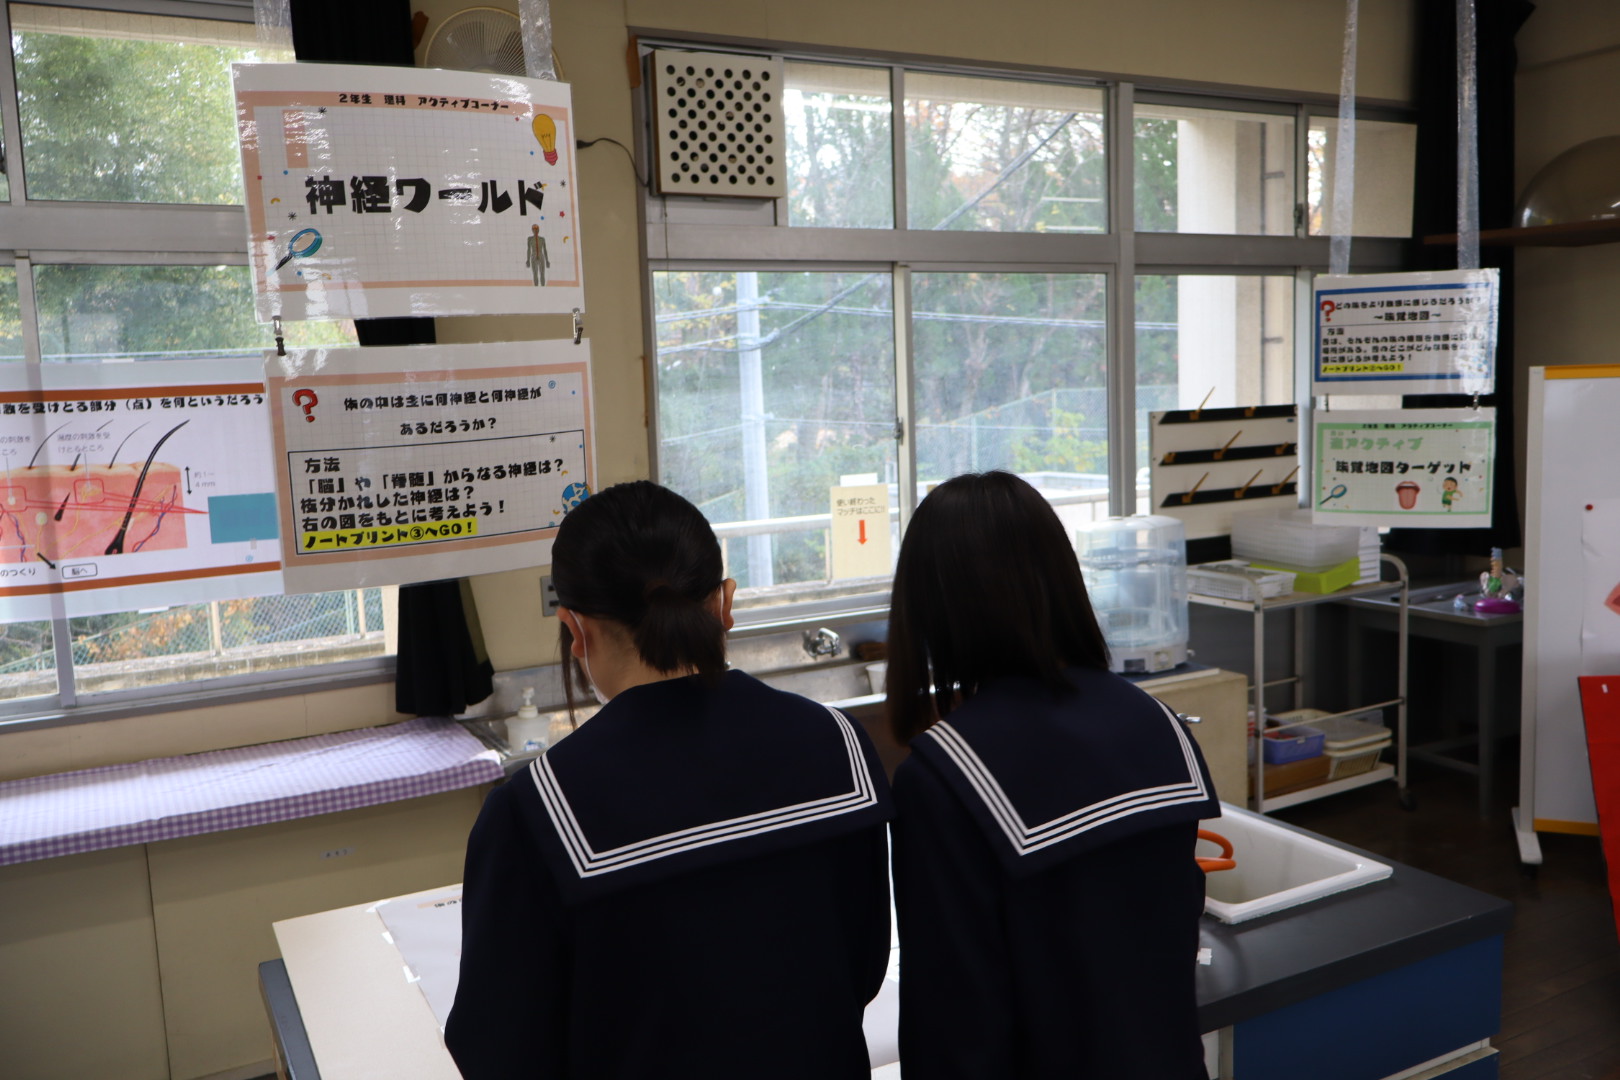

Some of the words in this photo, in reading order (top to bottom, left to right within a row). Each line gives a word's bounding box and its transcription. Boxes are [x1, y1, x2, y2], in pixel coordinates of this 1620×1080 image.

[338, 93, 373, 105] 2年生
[384, 94, 406, 106] 理科
[418, 95, 509, 111] アクティブコーナー
[305, 175, 545, 216] 神経ワールド
[0, 394, 264, 415] 激を受けとる部分（点）を何というだろう
[343, 386, 542, 411] 体の中は主に何神経と何神経が
[400, 417, 497, 436] あるだろうか？
[304, 456, 341, 474] 方法
[1335, 460, 1472, 475] 味覚地図ターゲット
[300, 486, 475, 513] 枝分かれした神経は？
[302, 500, 505, 533] 右の図をもとに考えよう！
